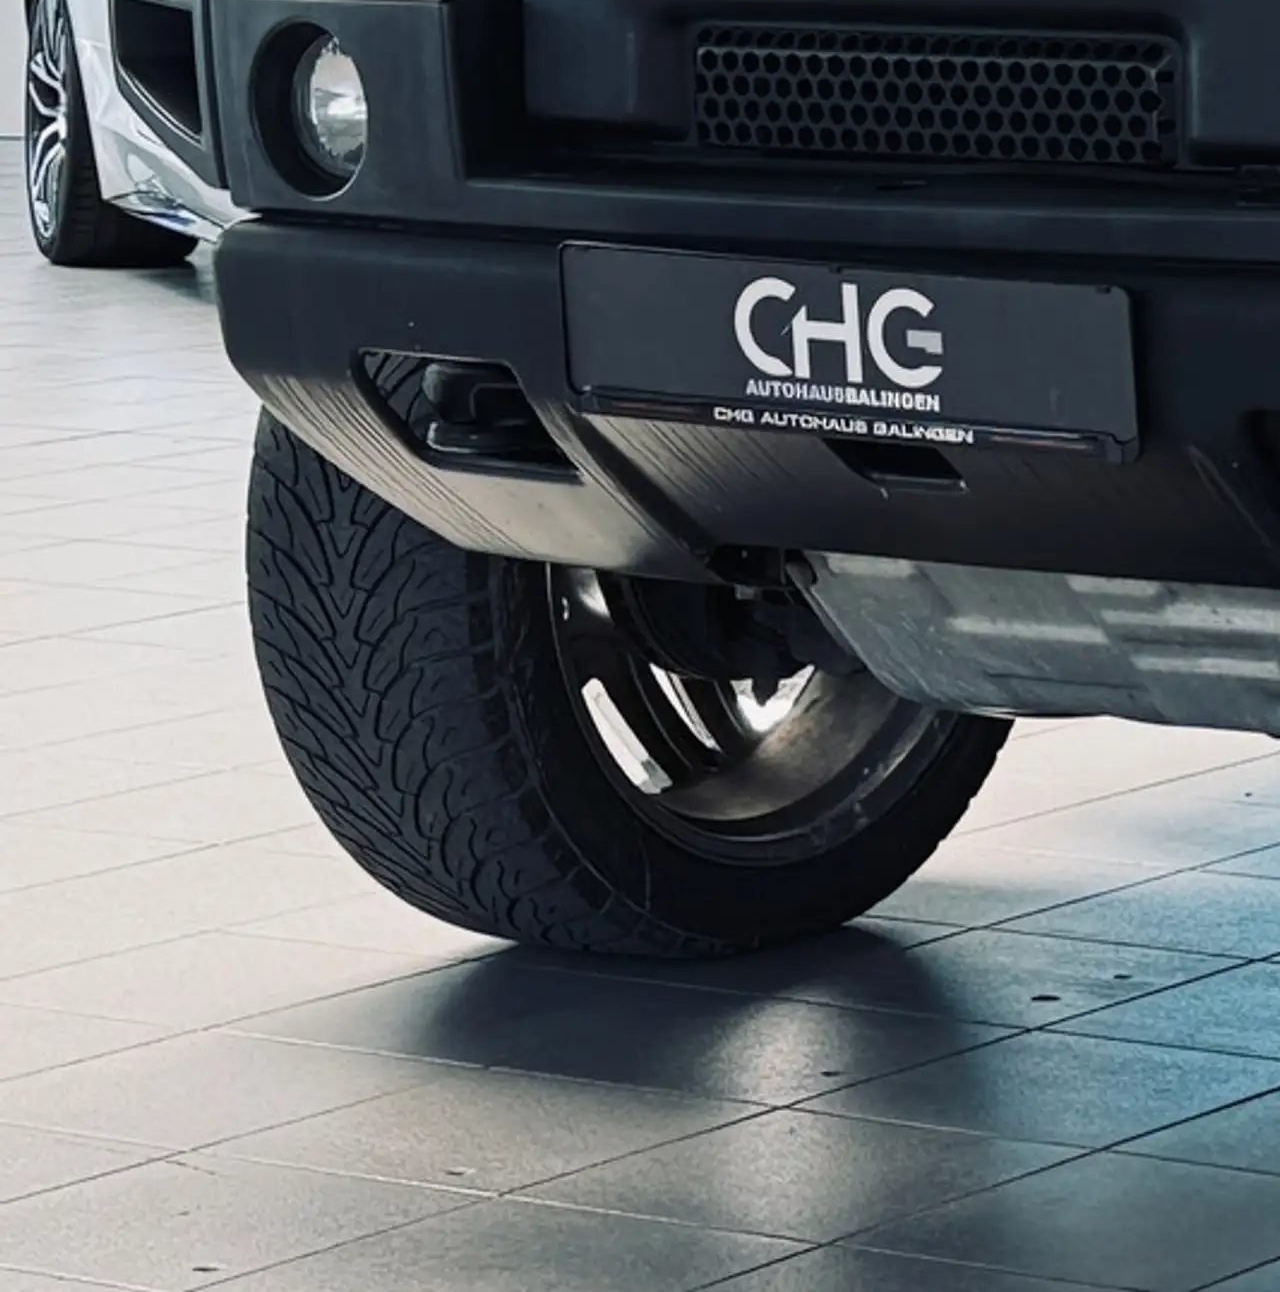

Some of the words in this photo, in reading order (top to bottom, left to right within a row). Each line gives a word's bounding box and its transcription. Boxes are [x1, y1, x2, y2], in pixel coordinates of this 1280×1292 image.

[734, 277, 943, 388] CHG
[713, 406, 755, 424] CHG
[760, 411, 869, 434] AUTOHAUS
[872, 421, 974, 444] BALINGEN
